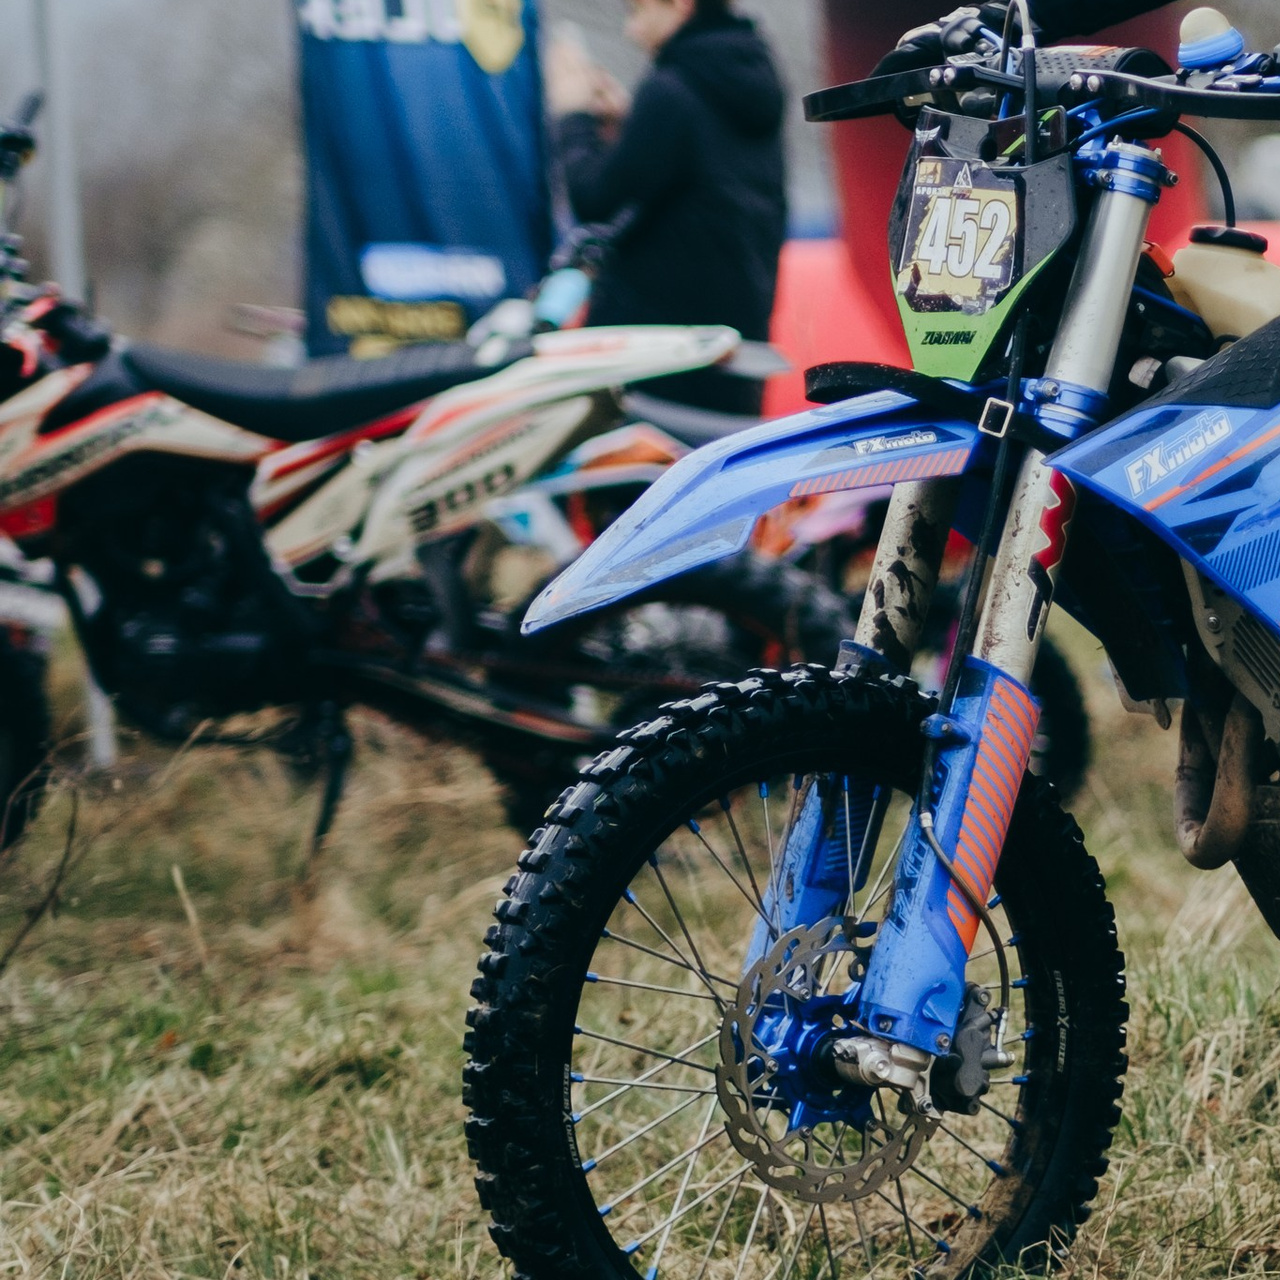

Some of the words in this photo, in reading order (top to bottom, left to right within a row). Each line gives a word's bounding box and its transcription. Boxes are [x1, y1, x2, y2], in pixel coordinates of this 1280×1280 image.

[918, 196, 1011, 279] 452
[853, 430, 937, 455] FXmoto
[1124, 410, 1232, 499] FXmoto
[1057, 1015, 1070, 1028] X
